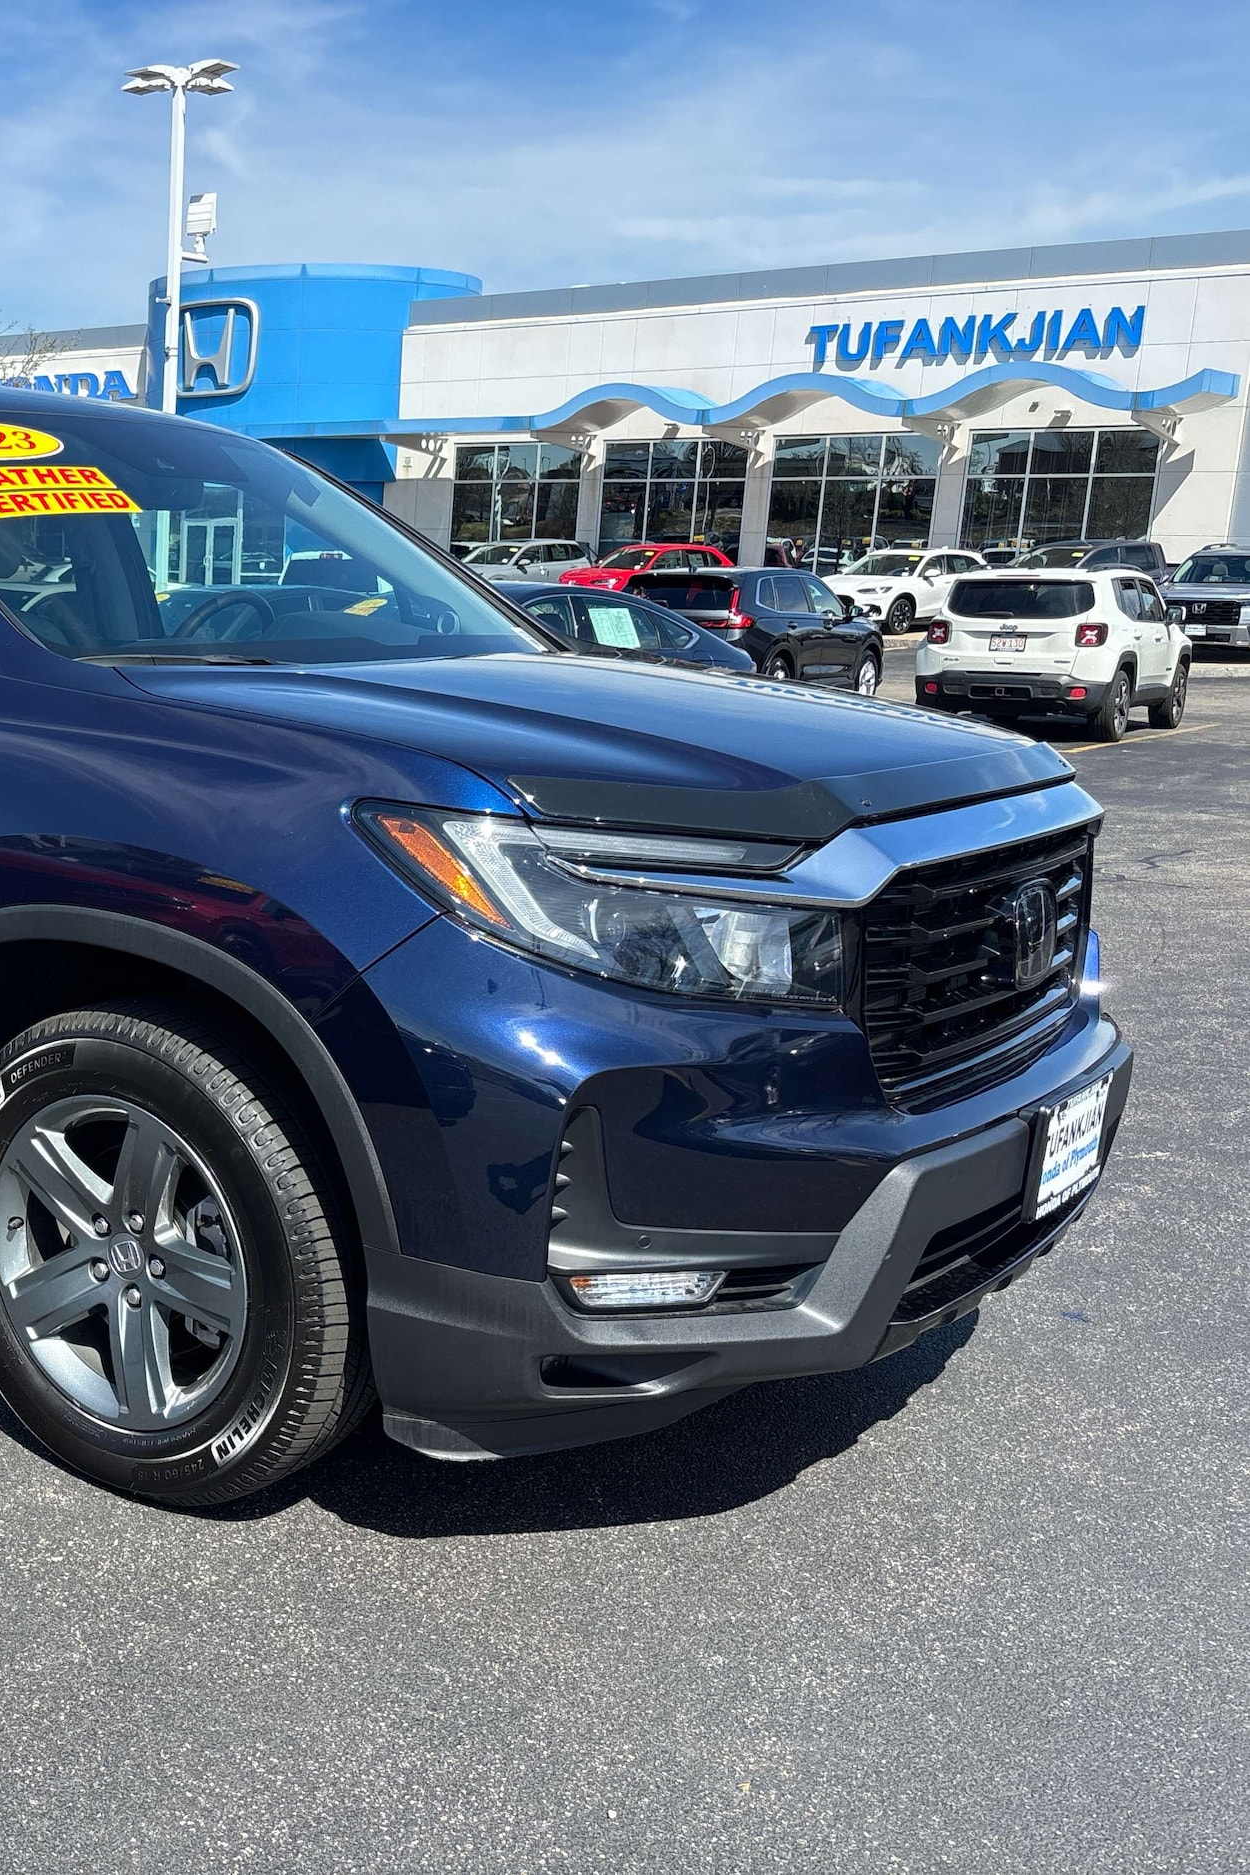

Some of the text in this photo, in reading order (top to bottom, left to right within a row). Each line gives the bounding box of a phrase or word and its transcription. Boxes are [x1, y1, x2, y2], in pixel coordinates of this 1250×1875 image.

[809, 305, 1145, 364] TUFANKJIAN
[1040, 1161, 1061, 1185] onda
[1062, 1152, 1071, 1173] of
[1036, 1193, 1061, 1220] HONDA
